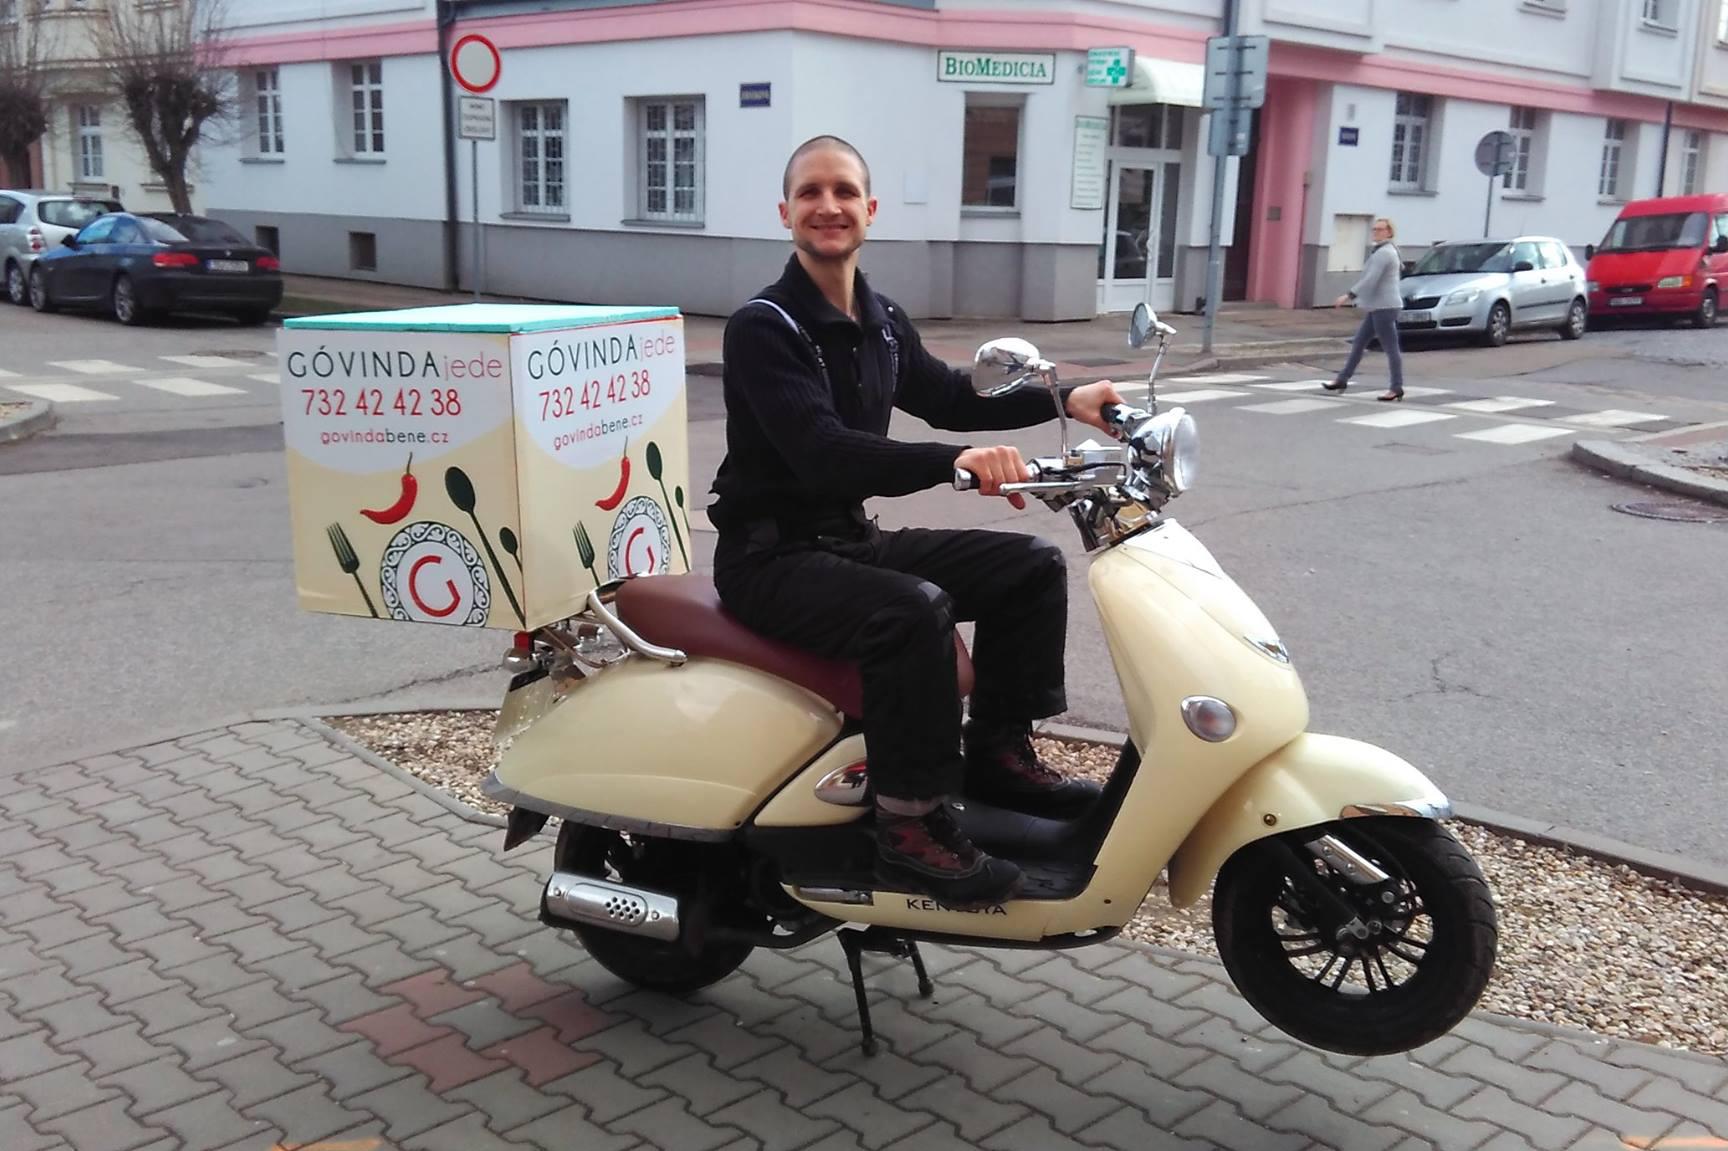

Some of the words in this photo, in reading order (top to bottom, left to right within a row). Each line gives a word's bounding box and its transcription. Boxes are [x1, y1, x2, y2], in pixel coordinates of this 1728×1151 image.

[302, 388, 347, 416] 732
[355, 388, 384, 416] 42
[393, 388, 423, 416] 42
[430, 388, 462, 416] 38
[539, 386, 575, 421] 732
[580, 380, 602, 410] 42
[607, 374, 627, 403] 42
[631, 369, 651, 398] 38
[320, 428, 449, 445] govindabene.cz
[553, 413, 644, 451] govindabene.cz
